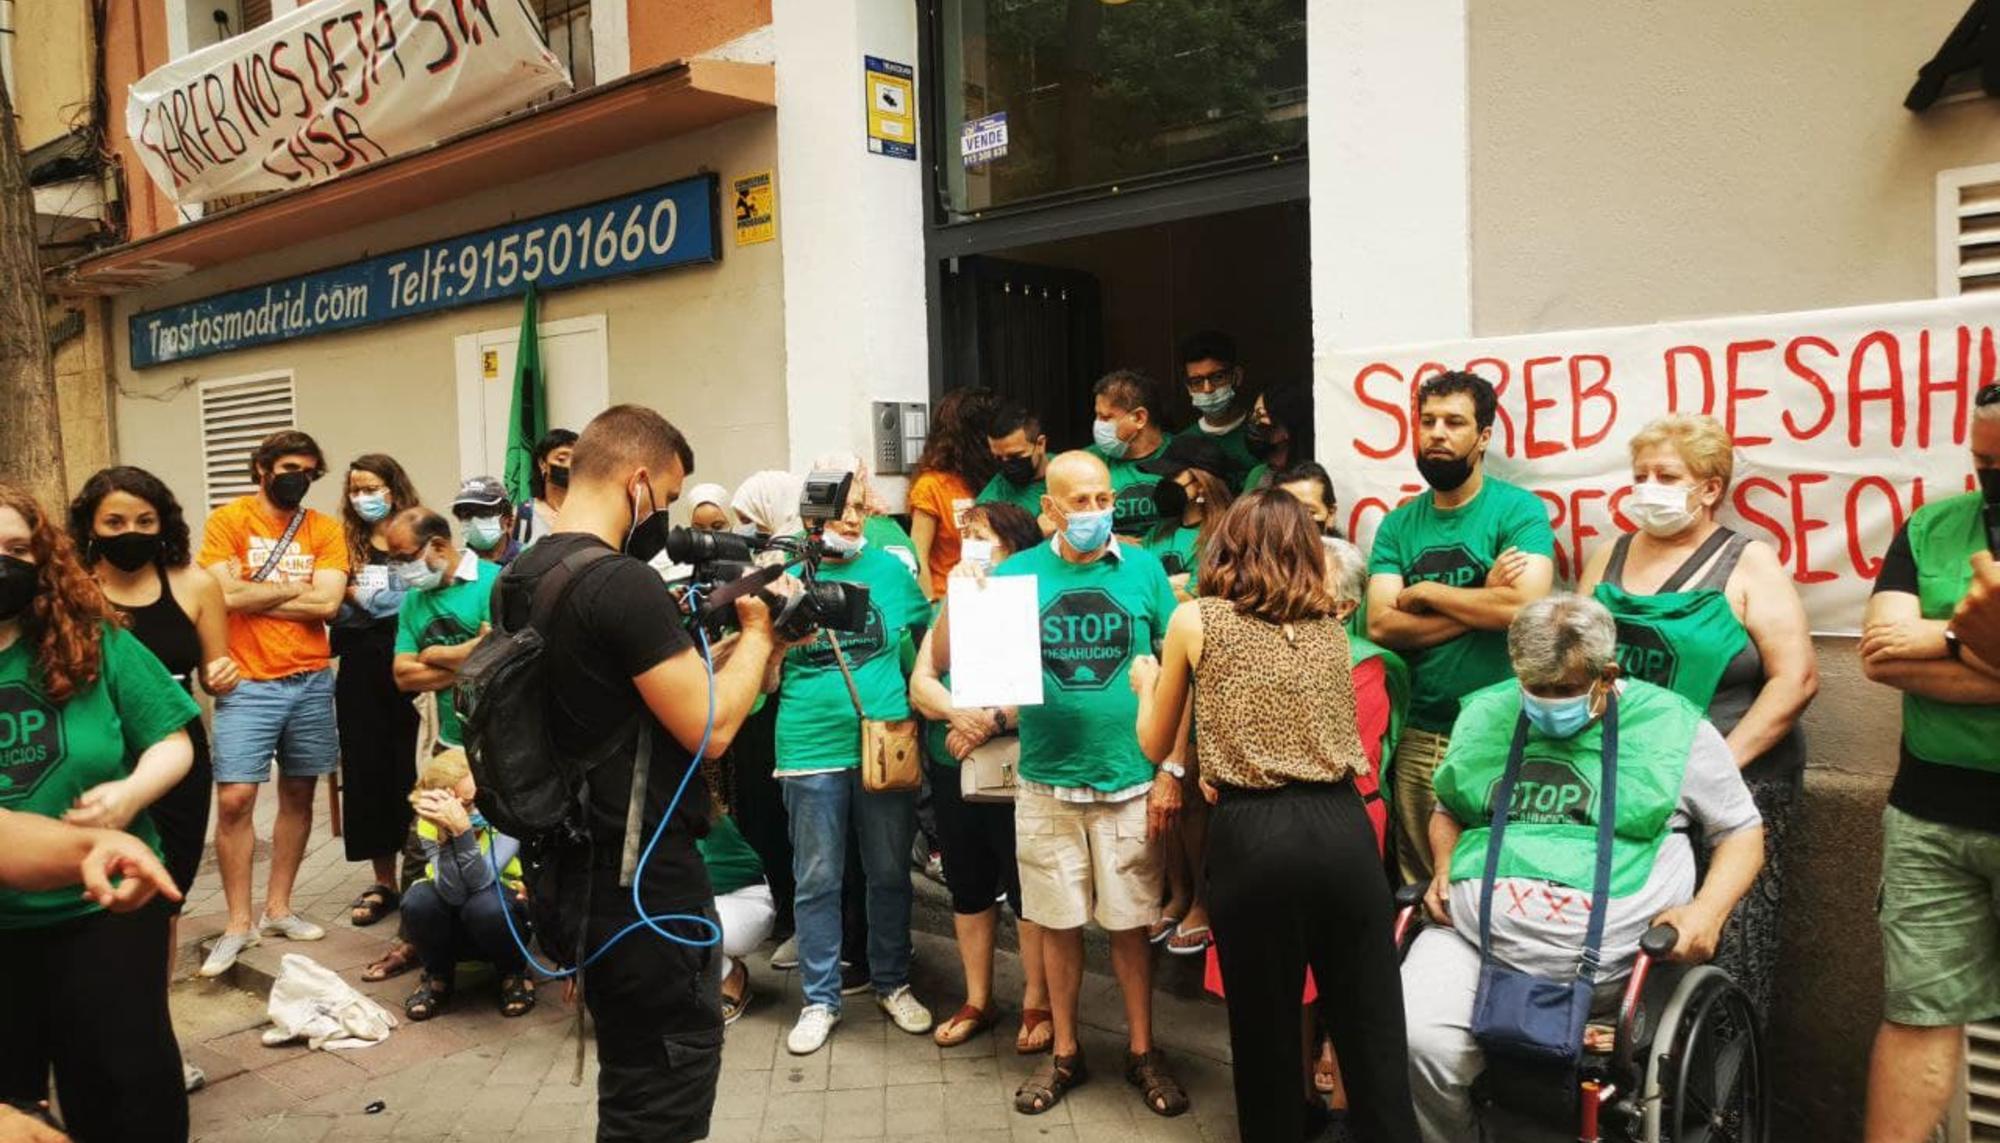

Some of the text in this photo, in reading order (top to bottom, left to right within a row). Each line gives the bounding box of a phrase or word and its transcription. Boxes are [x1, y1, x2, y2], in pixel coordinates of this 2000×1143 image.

[140, 73, 247, 187] SAREB
[232, 41, 313, 137] NOS
[965, 129, 1003, 151] VENDE
[262, 107, 388, 181] CASA
[149, 198, 678, 357] Trastosmadrid.com Telf:915501660
[1663, 325, 1997, 449] DESAH
[1114, 496, 1157, 518] STO
[1043, 613, 1122, 643] STOP
[1614, 643, 1665, 678] TOP
